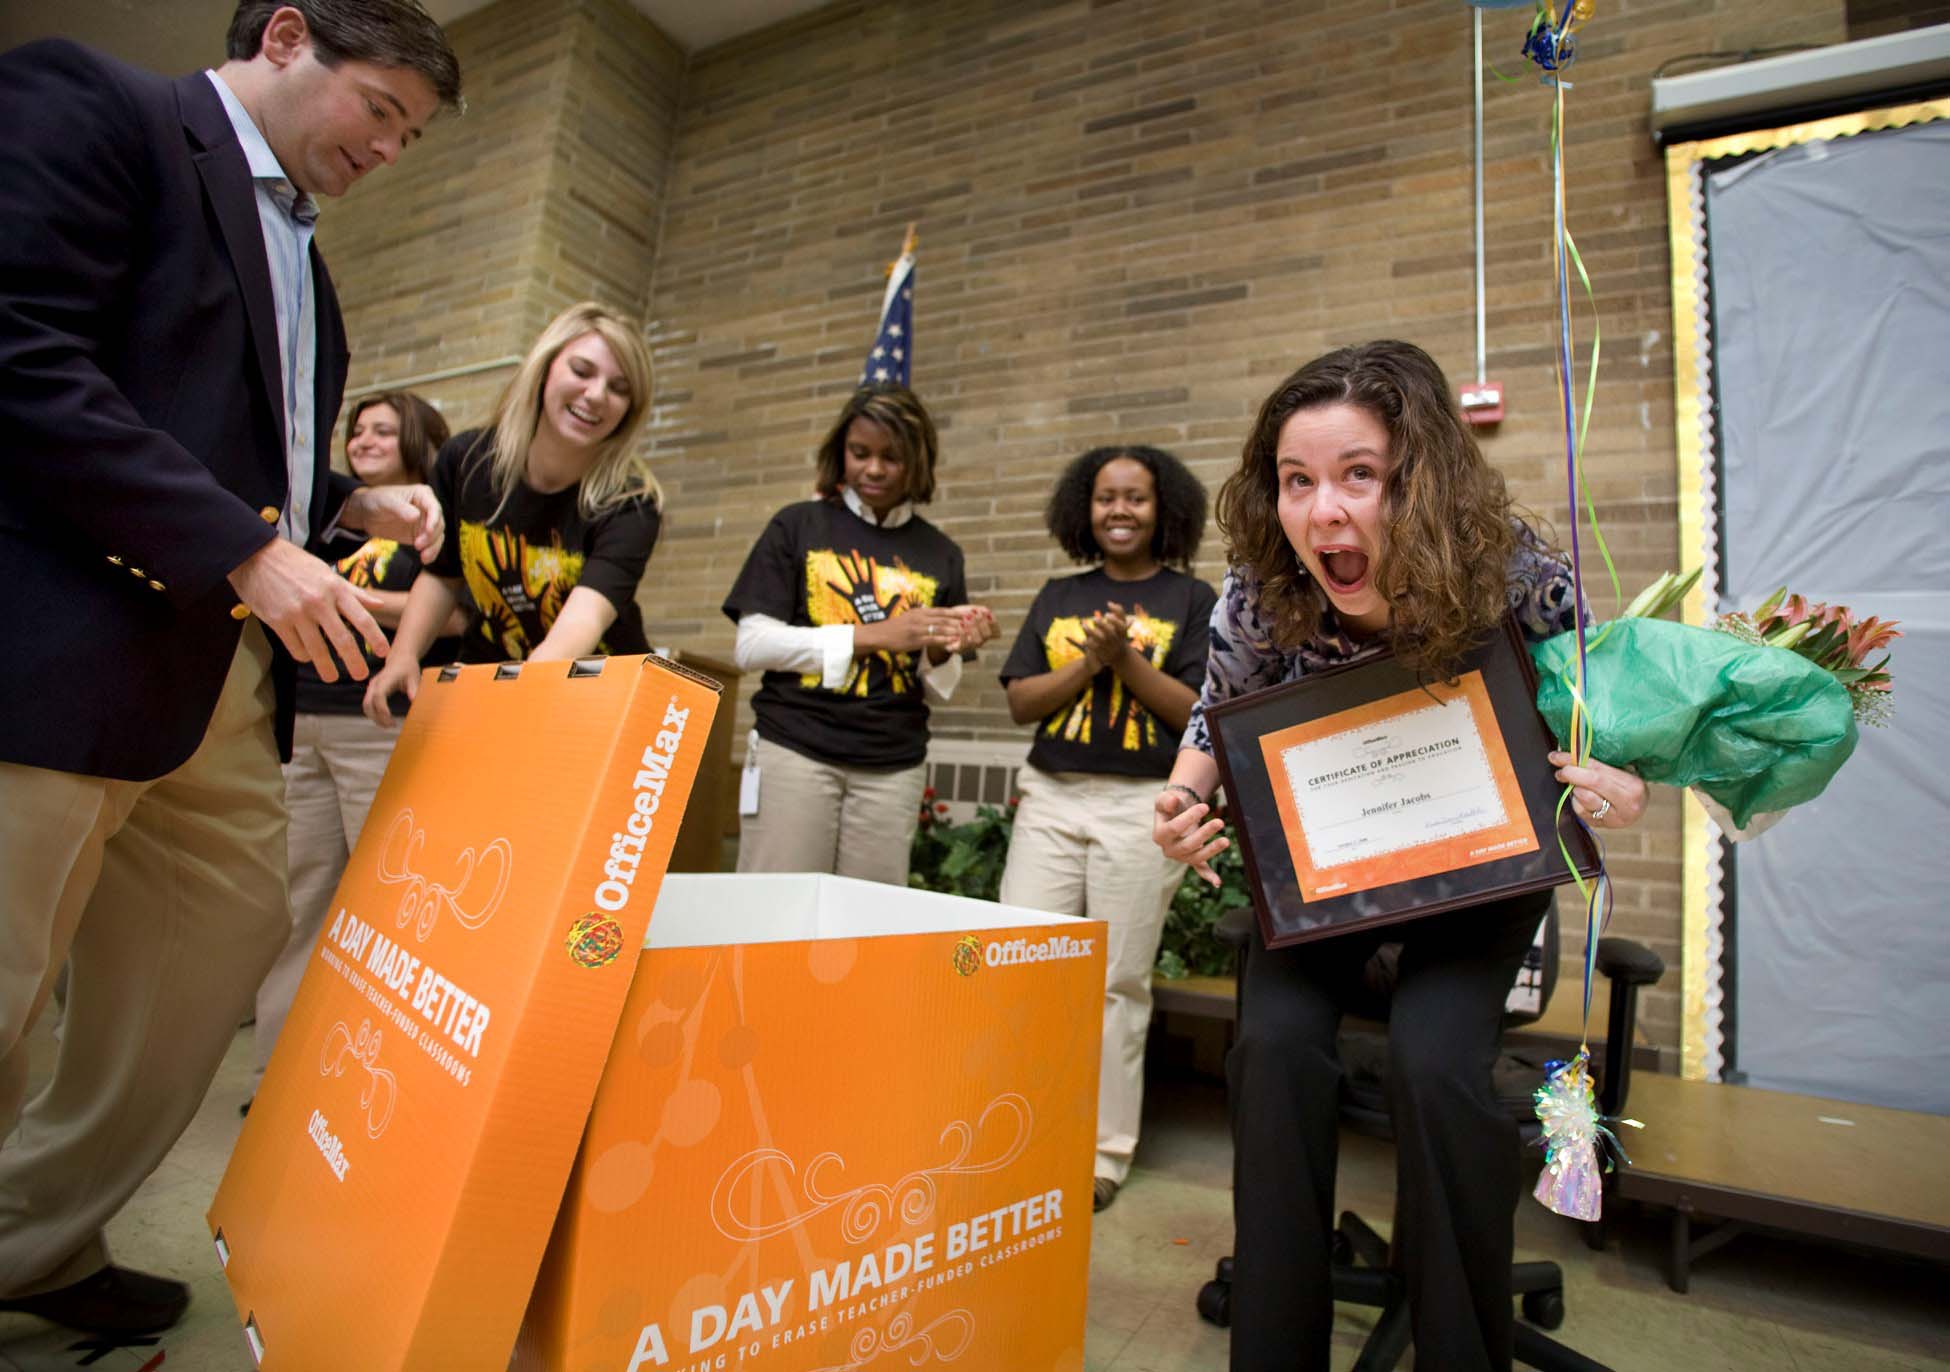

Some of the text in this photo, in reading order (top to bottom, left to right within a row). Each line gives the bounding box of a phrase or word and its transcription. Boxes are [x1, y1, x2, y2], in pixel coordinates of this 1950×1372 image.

[1308, 764, 1367, 786] CERTIFICATE
[1370, 759, 1382, 769] OF
[1387, 738, 1460, 764] APPRECIATION
[594, 700, 690, 911] OfficeMax
[1361, 792, 1431, 817] Jennifer Jacobs
[328, 908, 490, 1057] A DAY MADE BETTER
[985, 935, 1094, 967] OfficeMax
[418, 1032, 472, 1087] CLASSROOMS
[307, 1109, 350, 1182] OfficeMax
[626, 1188, 1064, 1372] A DAY MADE BETTER
[739, 1341, 760, 1361] TO
[772, 1316, 829, 1350] ERASE
[838, 1262, 974, 1324] TEACHER-FUNDED
[980, 1226, 1063, 1268] CLASSROOMS
